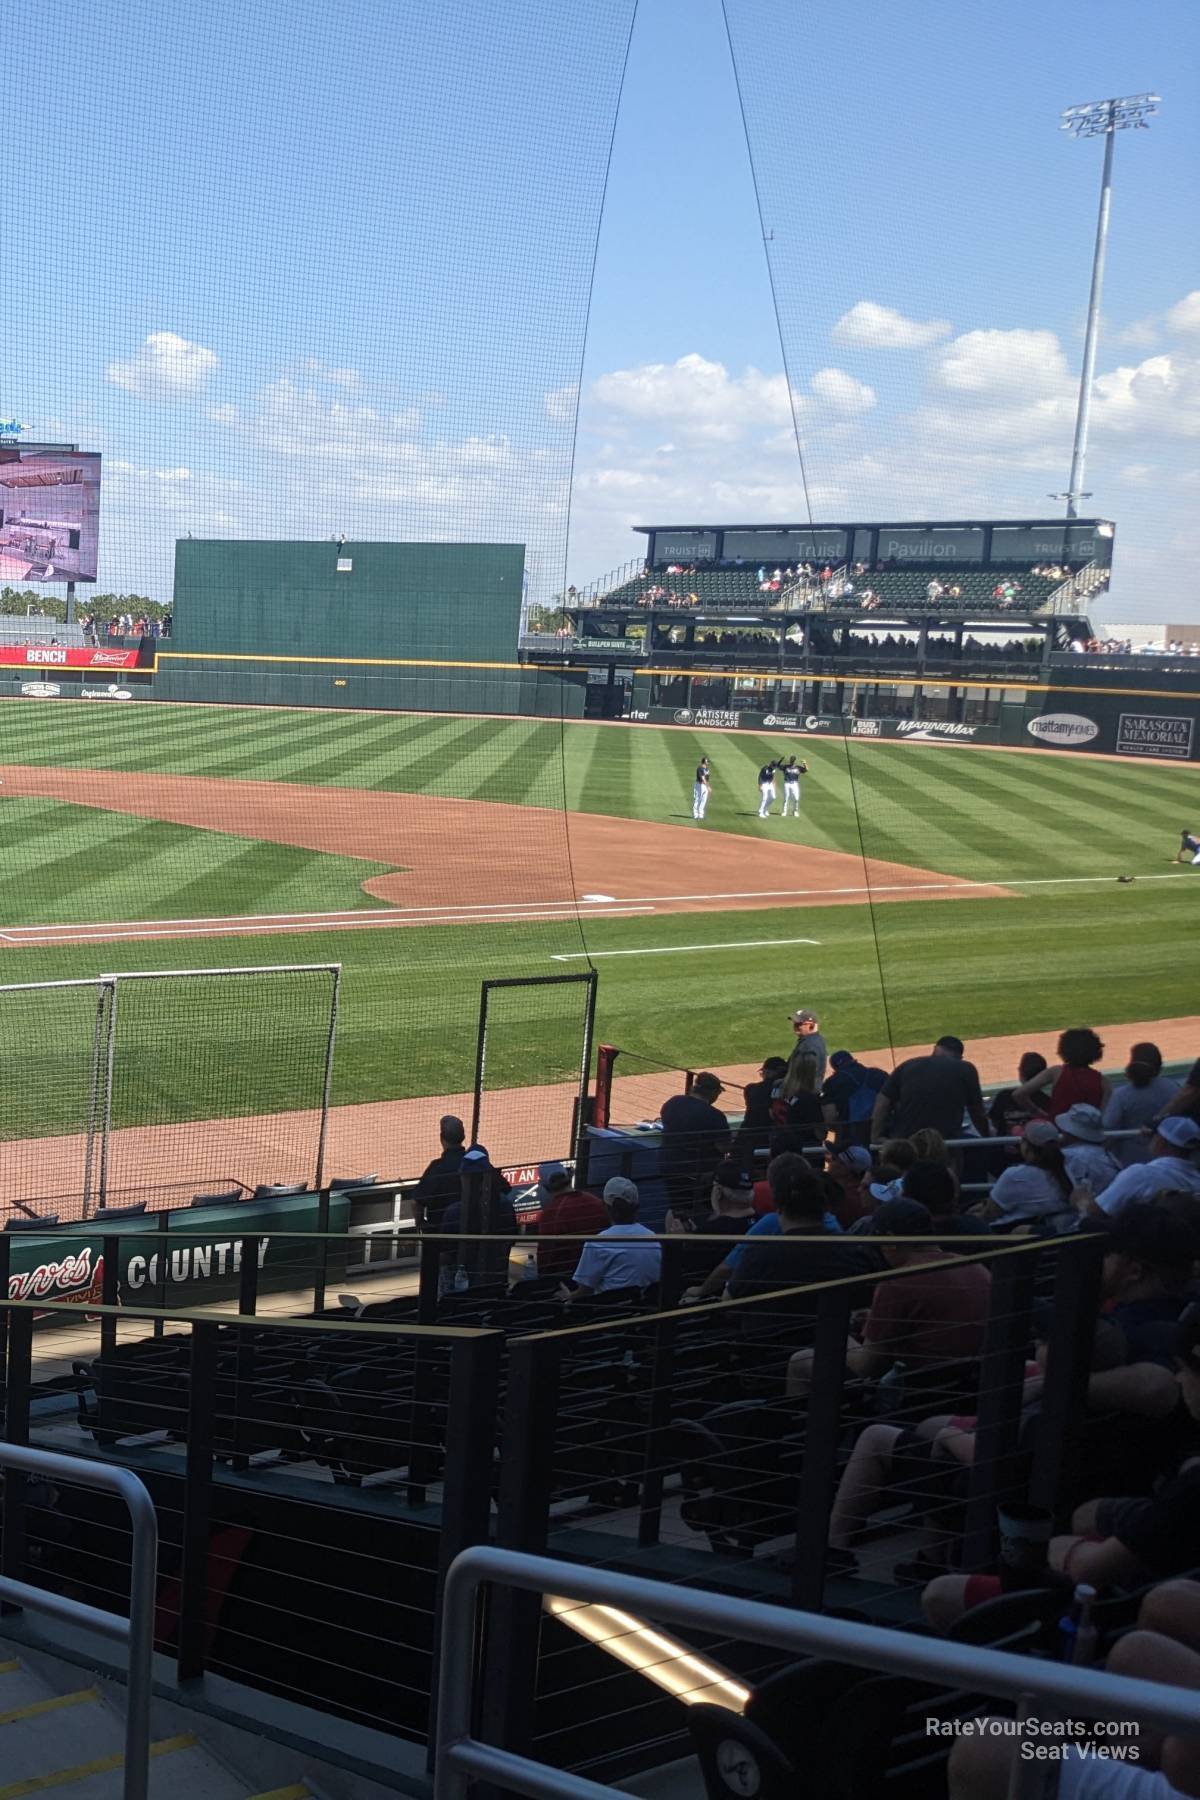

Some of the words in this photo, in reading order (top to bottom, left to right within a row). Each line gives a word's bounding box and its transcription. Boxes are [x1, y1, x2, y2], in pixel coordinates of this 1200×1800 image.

[664, 546, 697, 556] TRUIST
[798, 542, 842, 558] Truist
[887, 540, 957, 557] Pavilion
[1035, 543, 1076, 554] TRUIST
[27, 650, 66, 663] BENCH
[630, 710, 649, 720] rter
[696, 710, 740, 720] ARTISTREE
[695, 718, 739, 727] LANDSCAPE
[1123, 718, 1188, 733] SARASOTA
[852, 727, 879, 735] LIGHT
[1122, 729, 1187, 744] MEMORIAL
[503, 1170, 518, 1184] OT
[519, 1169, 536, 1181] AN
